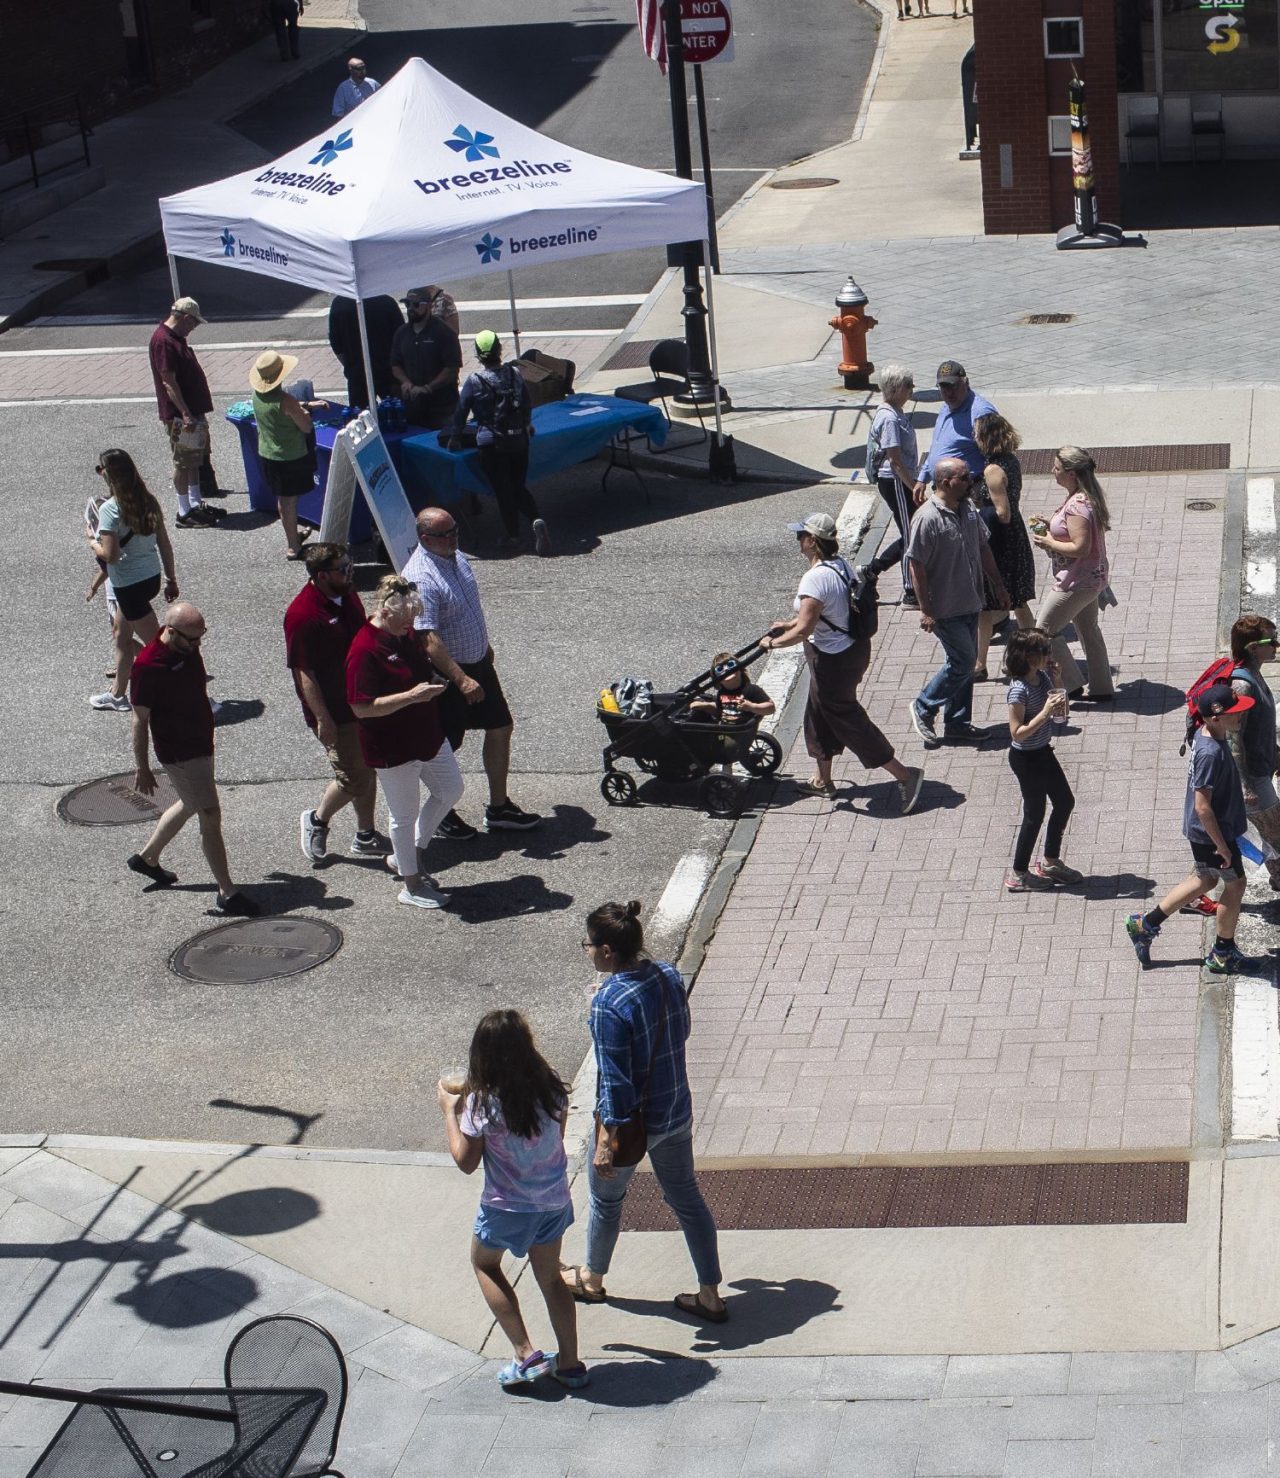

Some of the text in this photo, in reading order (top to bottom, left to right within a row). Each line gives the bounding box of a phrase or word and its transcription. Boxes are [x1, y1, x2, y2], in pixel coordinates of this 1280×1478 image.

[692, 2, 718, 14] NOT
[682, 36, 716, 48] NTER
[254, 166, 346, 196] breezeline
[456, 180, 562, 201] Internet. TV. Voice.
